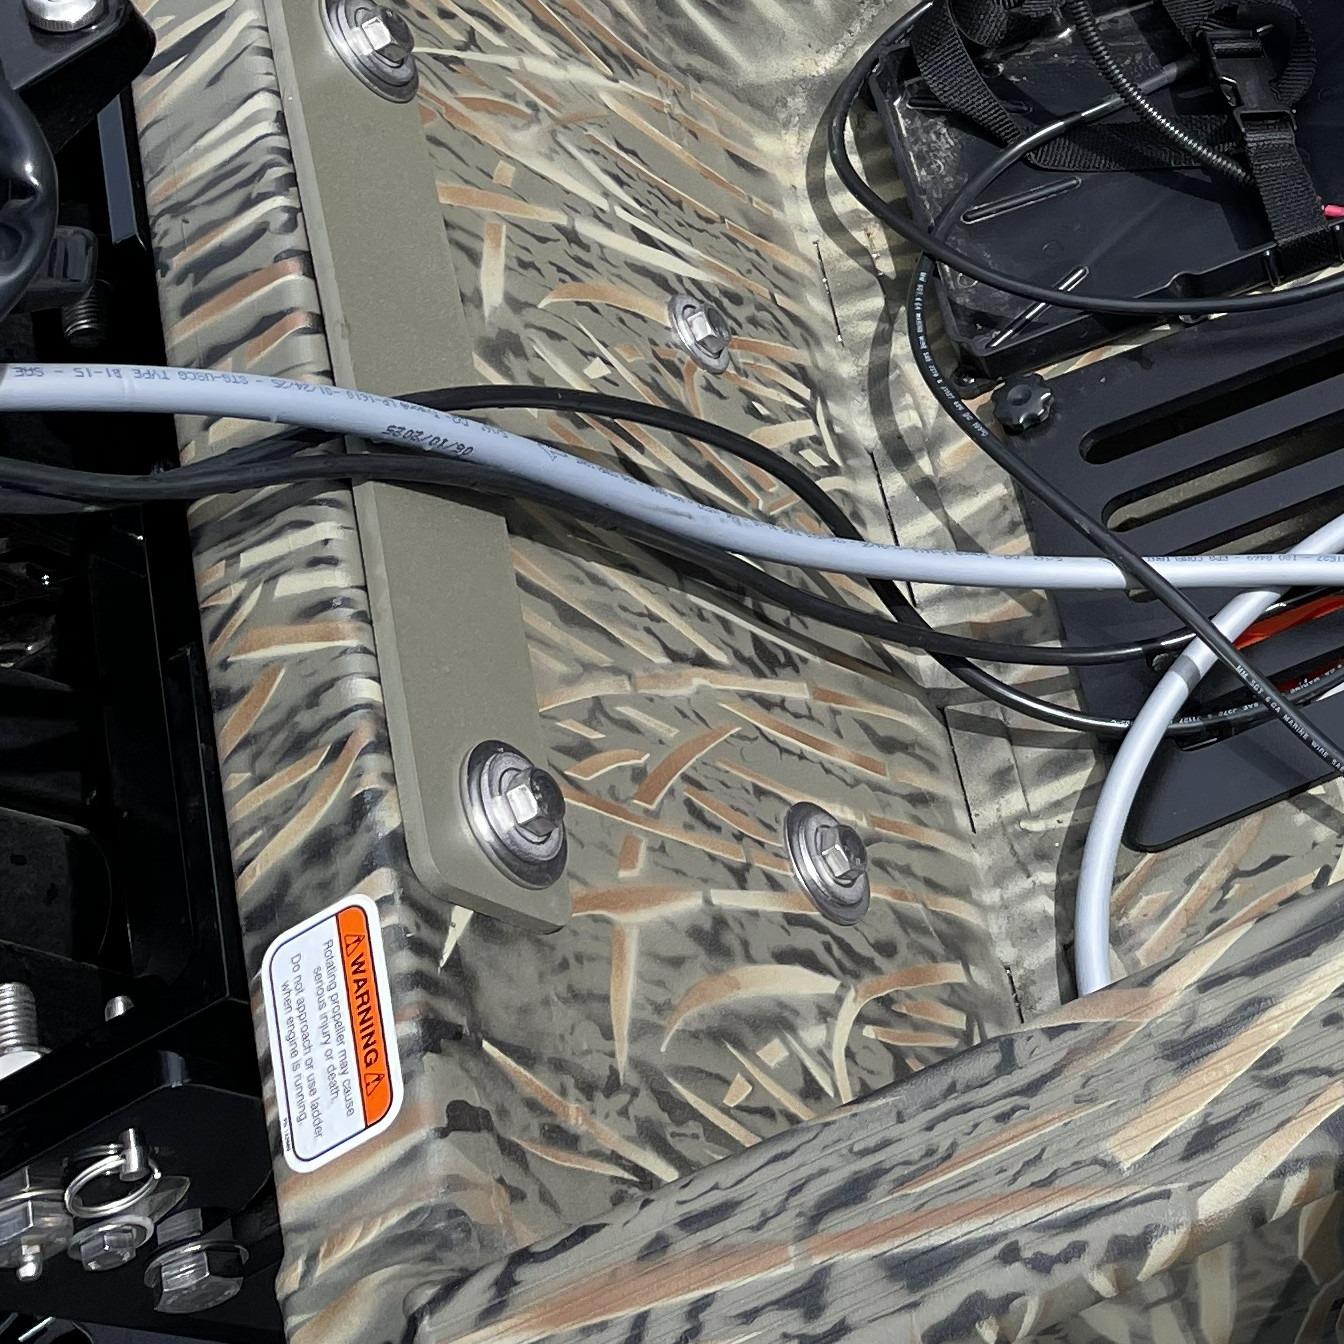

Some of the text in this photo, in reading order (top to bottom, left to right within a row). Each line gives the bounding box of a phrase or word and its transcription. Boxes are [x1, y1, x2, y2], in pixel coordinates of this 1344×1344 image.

[10, 366, 45, 376] SAE
[132, 368, 170, 381] TYPE
[380, 423, 475, 457] 06/10/2025
[1280, 712, 1311, 742] MARINE
[1309, 738, 1330, 759] WIRE
[290, 952, 303, 975] Do
[292, 974, 304, 996] not
[311, 966, 327, 1011] serious
[292, 997, 313, 1057] approach
[349, 951, 379, 1069] WARNING
[316, 1012, 332, 1047] injury
[322, 939, 356, 1117] Rotating propeller may cause
[281, 980, 308, 1127] when engine is running.
[304, 1058, 314, 1072] or
[324, 1048, 333, 1063] or
[305, 1073, 317, 1098] use
